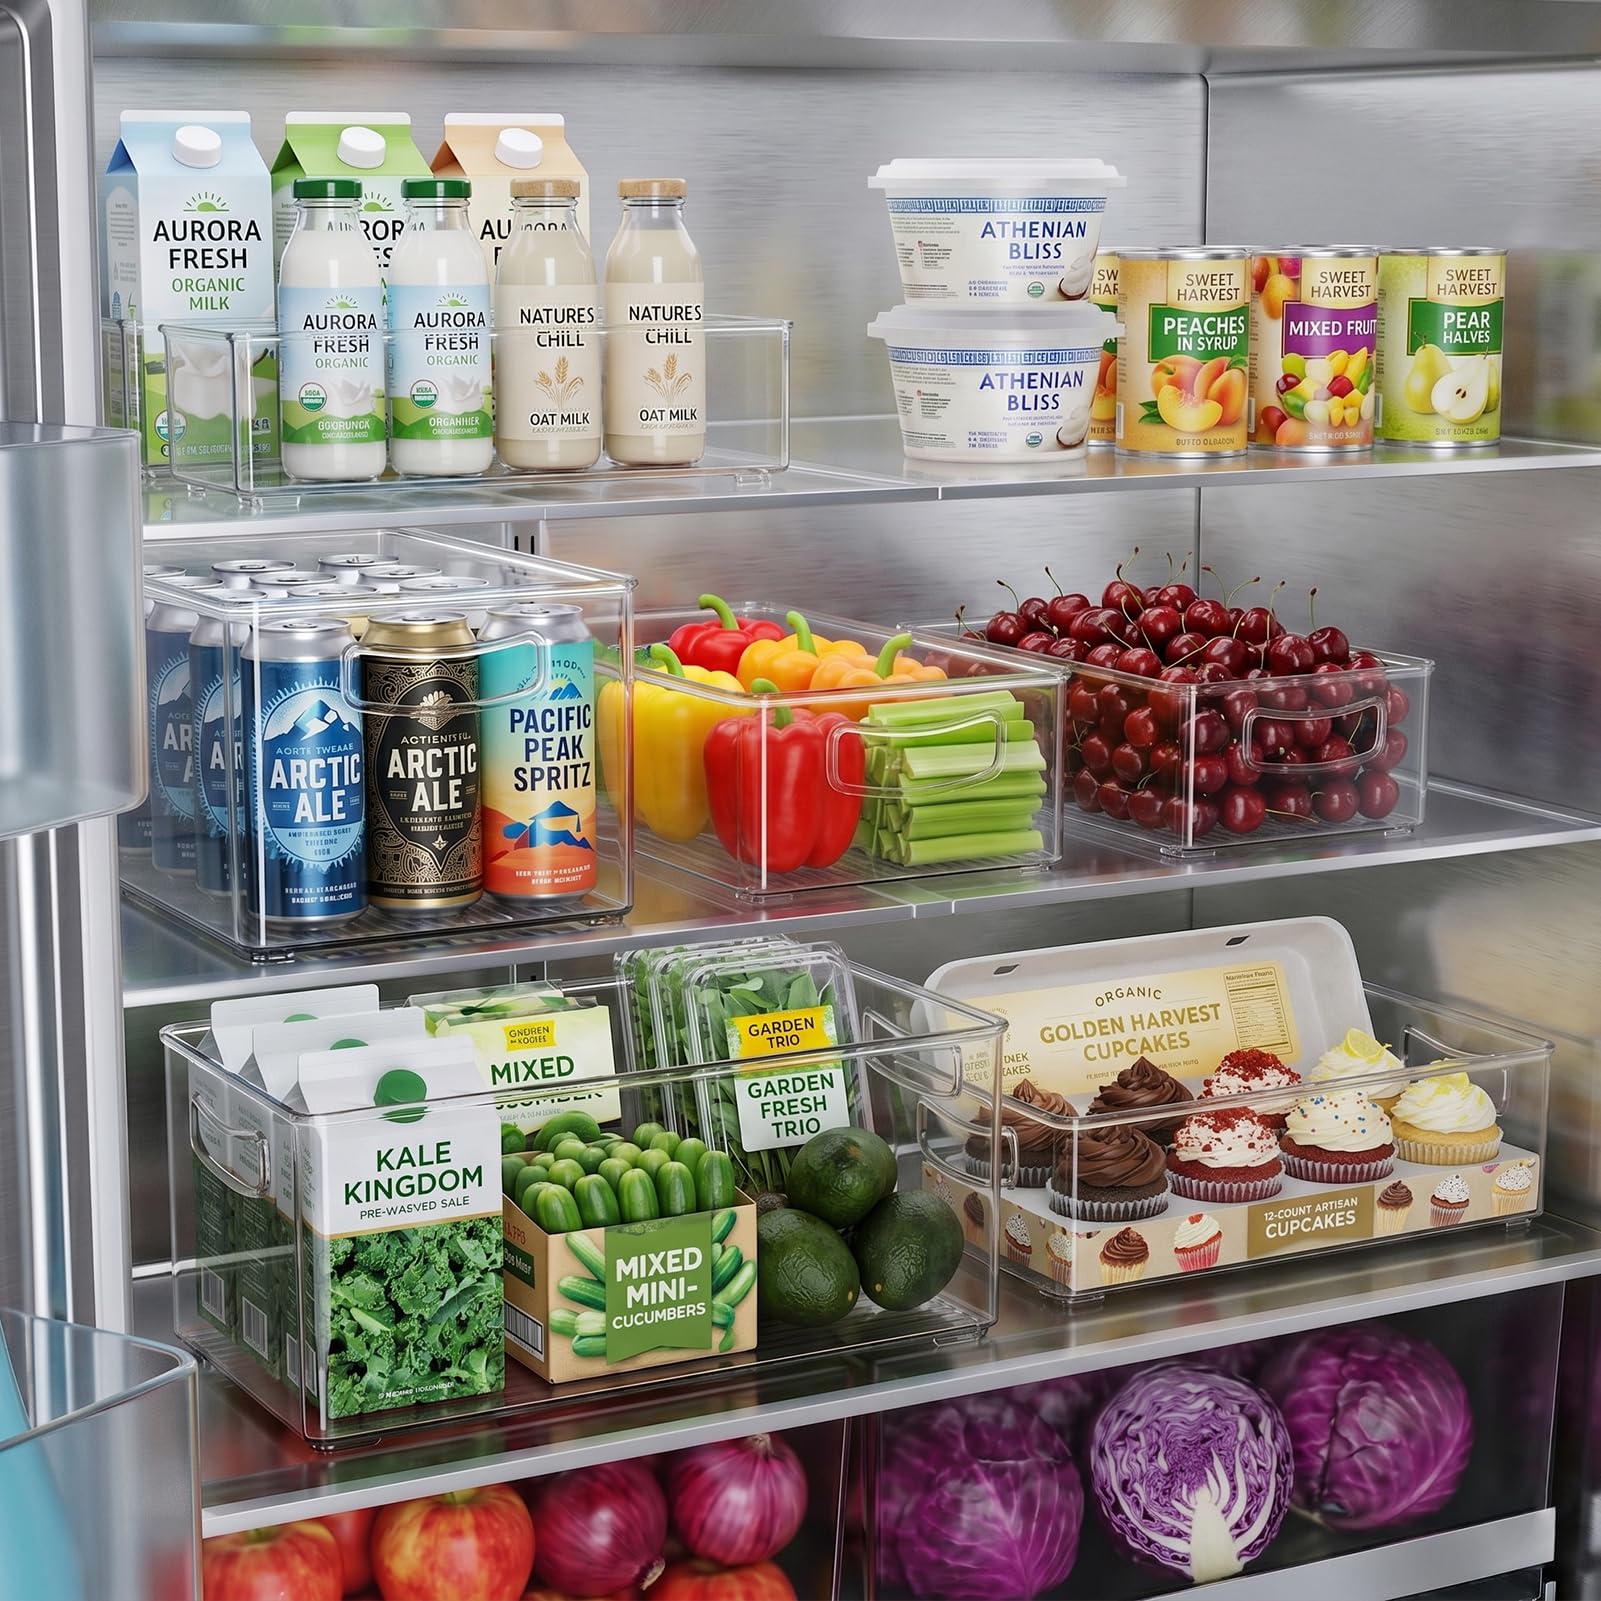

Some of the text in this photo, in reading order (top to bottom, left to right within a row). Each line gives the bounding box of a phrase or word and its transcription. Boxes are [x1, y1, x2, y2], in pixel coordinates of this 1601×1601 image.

[153, 220, 262, 242] AURORA
[980, 220, 1087, 240] ATHENIAN
[169, 248, 247, 270] FRESH
[1008, 242, 1062, 261] BLISS
[1185, 272, 1235, 287] SWEET
[1319, 270, 1366, 284] SWEET
[1445, 268, 1492, 282] SWEET
[171, 277, 246, 293] ORGANIC
[1176, 287, 1240, 302] HARVEST
[1310, 284, 1372, 299] HARVEST
[1436, 282, 1498, 296] HARVEST
[190, 296, 230, 310] MILK
[303, 313, 378, 331] AURORA
[413, 311, 486, 329] AURORA
[519, 306, 595, 325] NATURES
[628, 304, 703, 322] NATURES
[1443, 311, 1490, 330] PEAR
[1163, 315, 1245, 336] PEACHES
[1288, 318, 1377, 337] MIXED FRUIT
[313, 334, 370, 353] FRESH
[424, 332, 479, 351] FRESH
[536, 329, 585, 347] CHILL
[645, 327, 692, 344] CHILL
[1177, 336, 1238, 351] IN SYRUP
[1442, 330, 1490, 344] HALVES
[315, 356, 369, 369] ORGANIC
[426, 353, 479, 366] ORGANIC
[979, 370, 1084, 391] ATHENIAN
[1007, 394, 1060, 412] BLISS
[529, 412, 590, 426] OAT MILK
[639, 408, 698, 422] OAT MILK
[510, 703, 591, 734] PACIFIC
[524, 734, 584, 763] PEAK
[387, 743, 478, 779] ARCTIC
[269, 752, 361, 790] ARCTIC
[513, 762, 591, 793] SPRITZ
[411, 778, 463, 812] ALE
[293, 789, 346, 824] ALE
[1095, 987, 1163, 1008] ORGANIC
[748, 1016, 815, 1037] GARDEN
[1039, 1002, 1222, 1045] GOLDEN HARVEST
[766, 1034, 800, 1049] TRIO
[1082, 1031, 1191, 1063] CUPCAKES
[490, 1055, 575, 1086] MIXED
[747, 1072, 834, 1099] GARDEN
[760, 1095, 828, 1119] FRESH
[771, 1117, 821, 1138] TRIO
[376, 1141, 452, 1172] KALE
[344, 1165, 483, 1206] KINGDOM
[440, 1195, 470, 1209] SALE
[1263, 1196, 1359, 1222] 12-COUNT ARTISAN
[1265, 1209, 1357, 1239] CUPCAKES
[615, 1246, 703, 1282] MIXED
[626, 1277, 698, 1309] MINI-
[611, 1302, 706, 1330] CUCUMBERS
